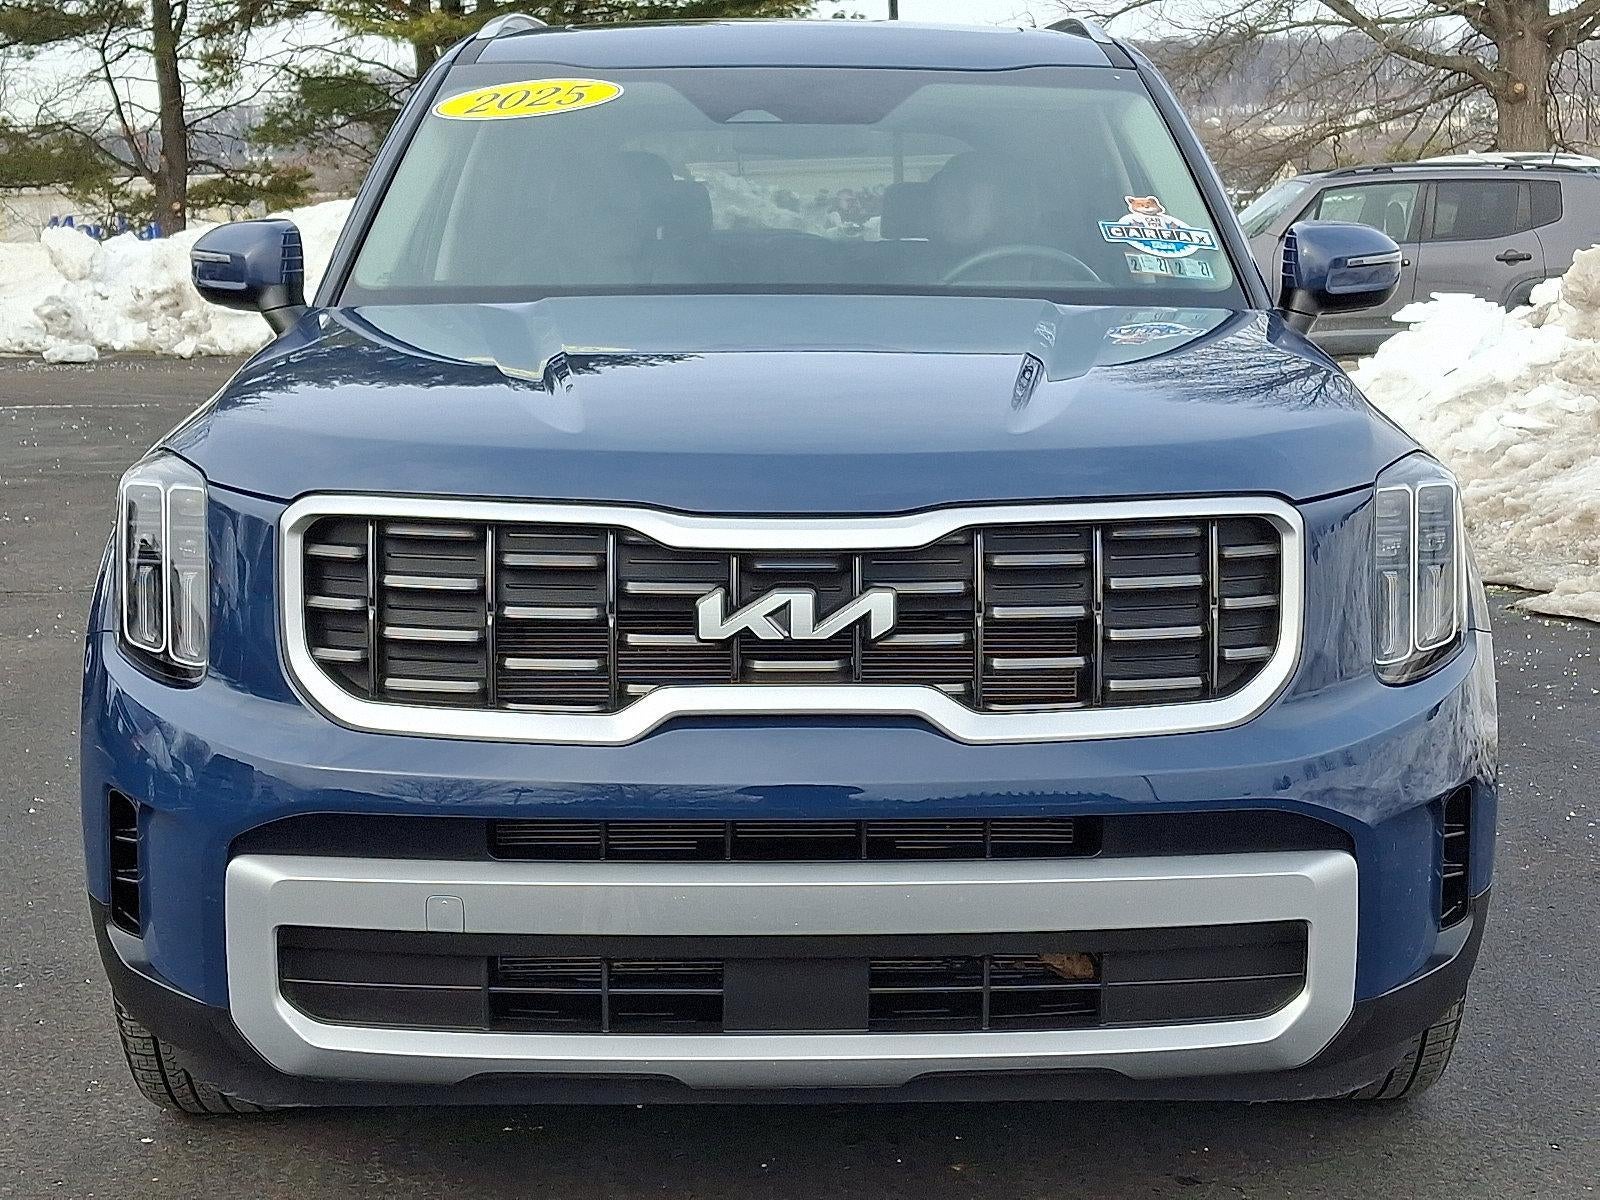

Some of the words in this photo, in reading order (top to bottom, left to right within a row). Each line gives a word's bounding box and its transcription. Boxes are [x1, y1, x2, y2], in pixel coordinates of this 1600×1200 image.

[464, 85, 592, 114] 2025
[1110, 227, 1206, 244] CARFAX
[695, 587, 897, 640] KIA
